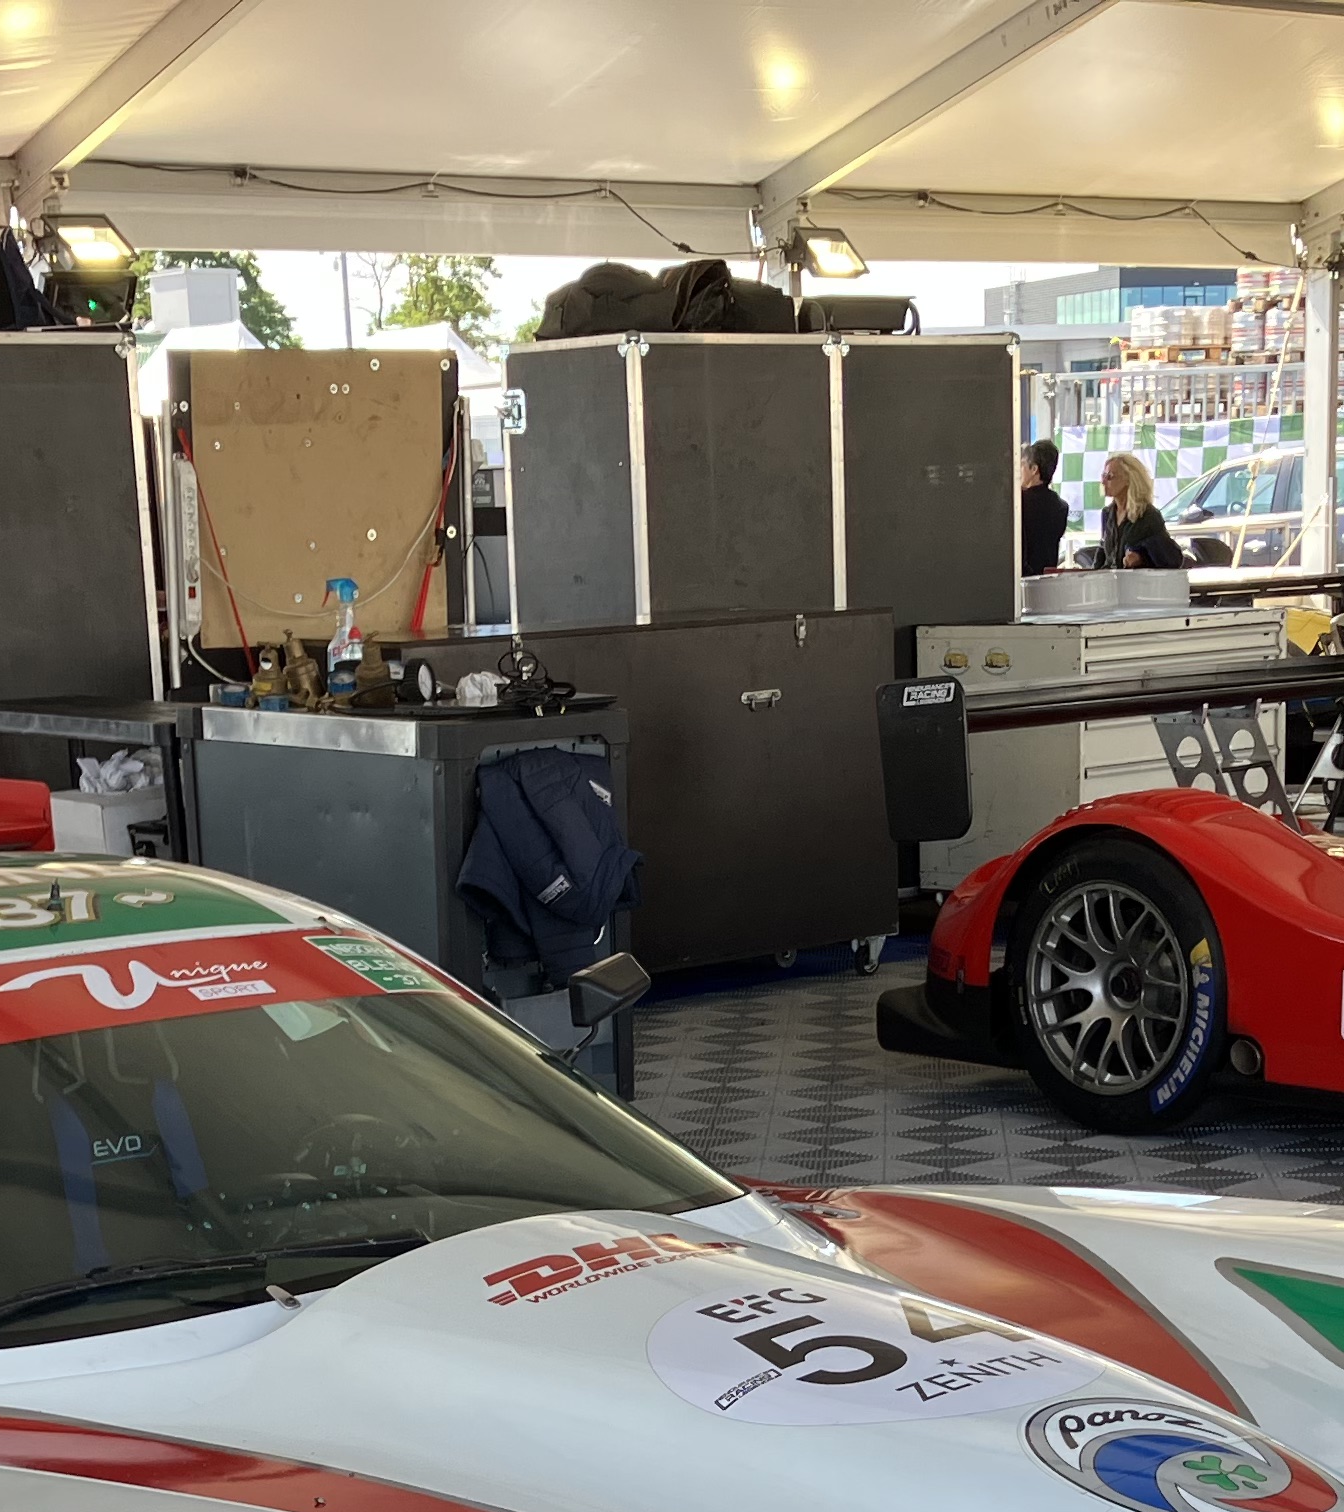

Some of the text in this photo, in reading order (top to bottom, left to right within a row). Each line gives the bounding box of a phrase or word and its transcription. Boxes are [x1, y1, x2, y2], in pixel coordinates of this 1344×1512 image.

[197, 982, 259, 999] SPORT
[1156, 992, 1211, 1105] MICHELIN
[93, 1134, 142, 1157] EVO
[525, 1260, 652, 1304] WORLDWIDE
[696, 1287, 828, 1324] EFG
[894, 1351, 1062, 1402] ZENITH
